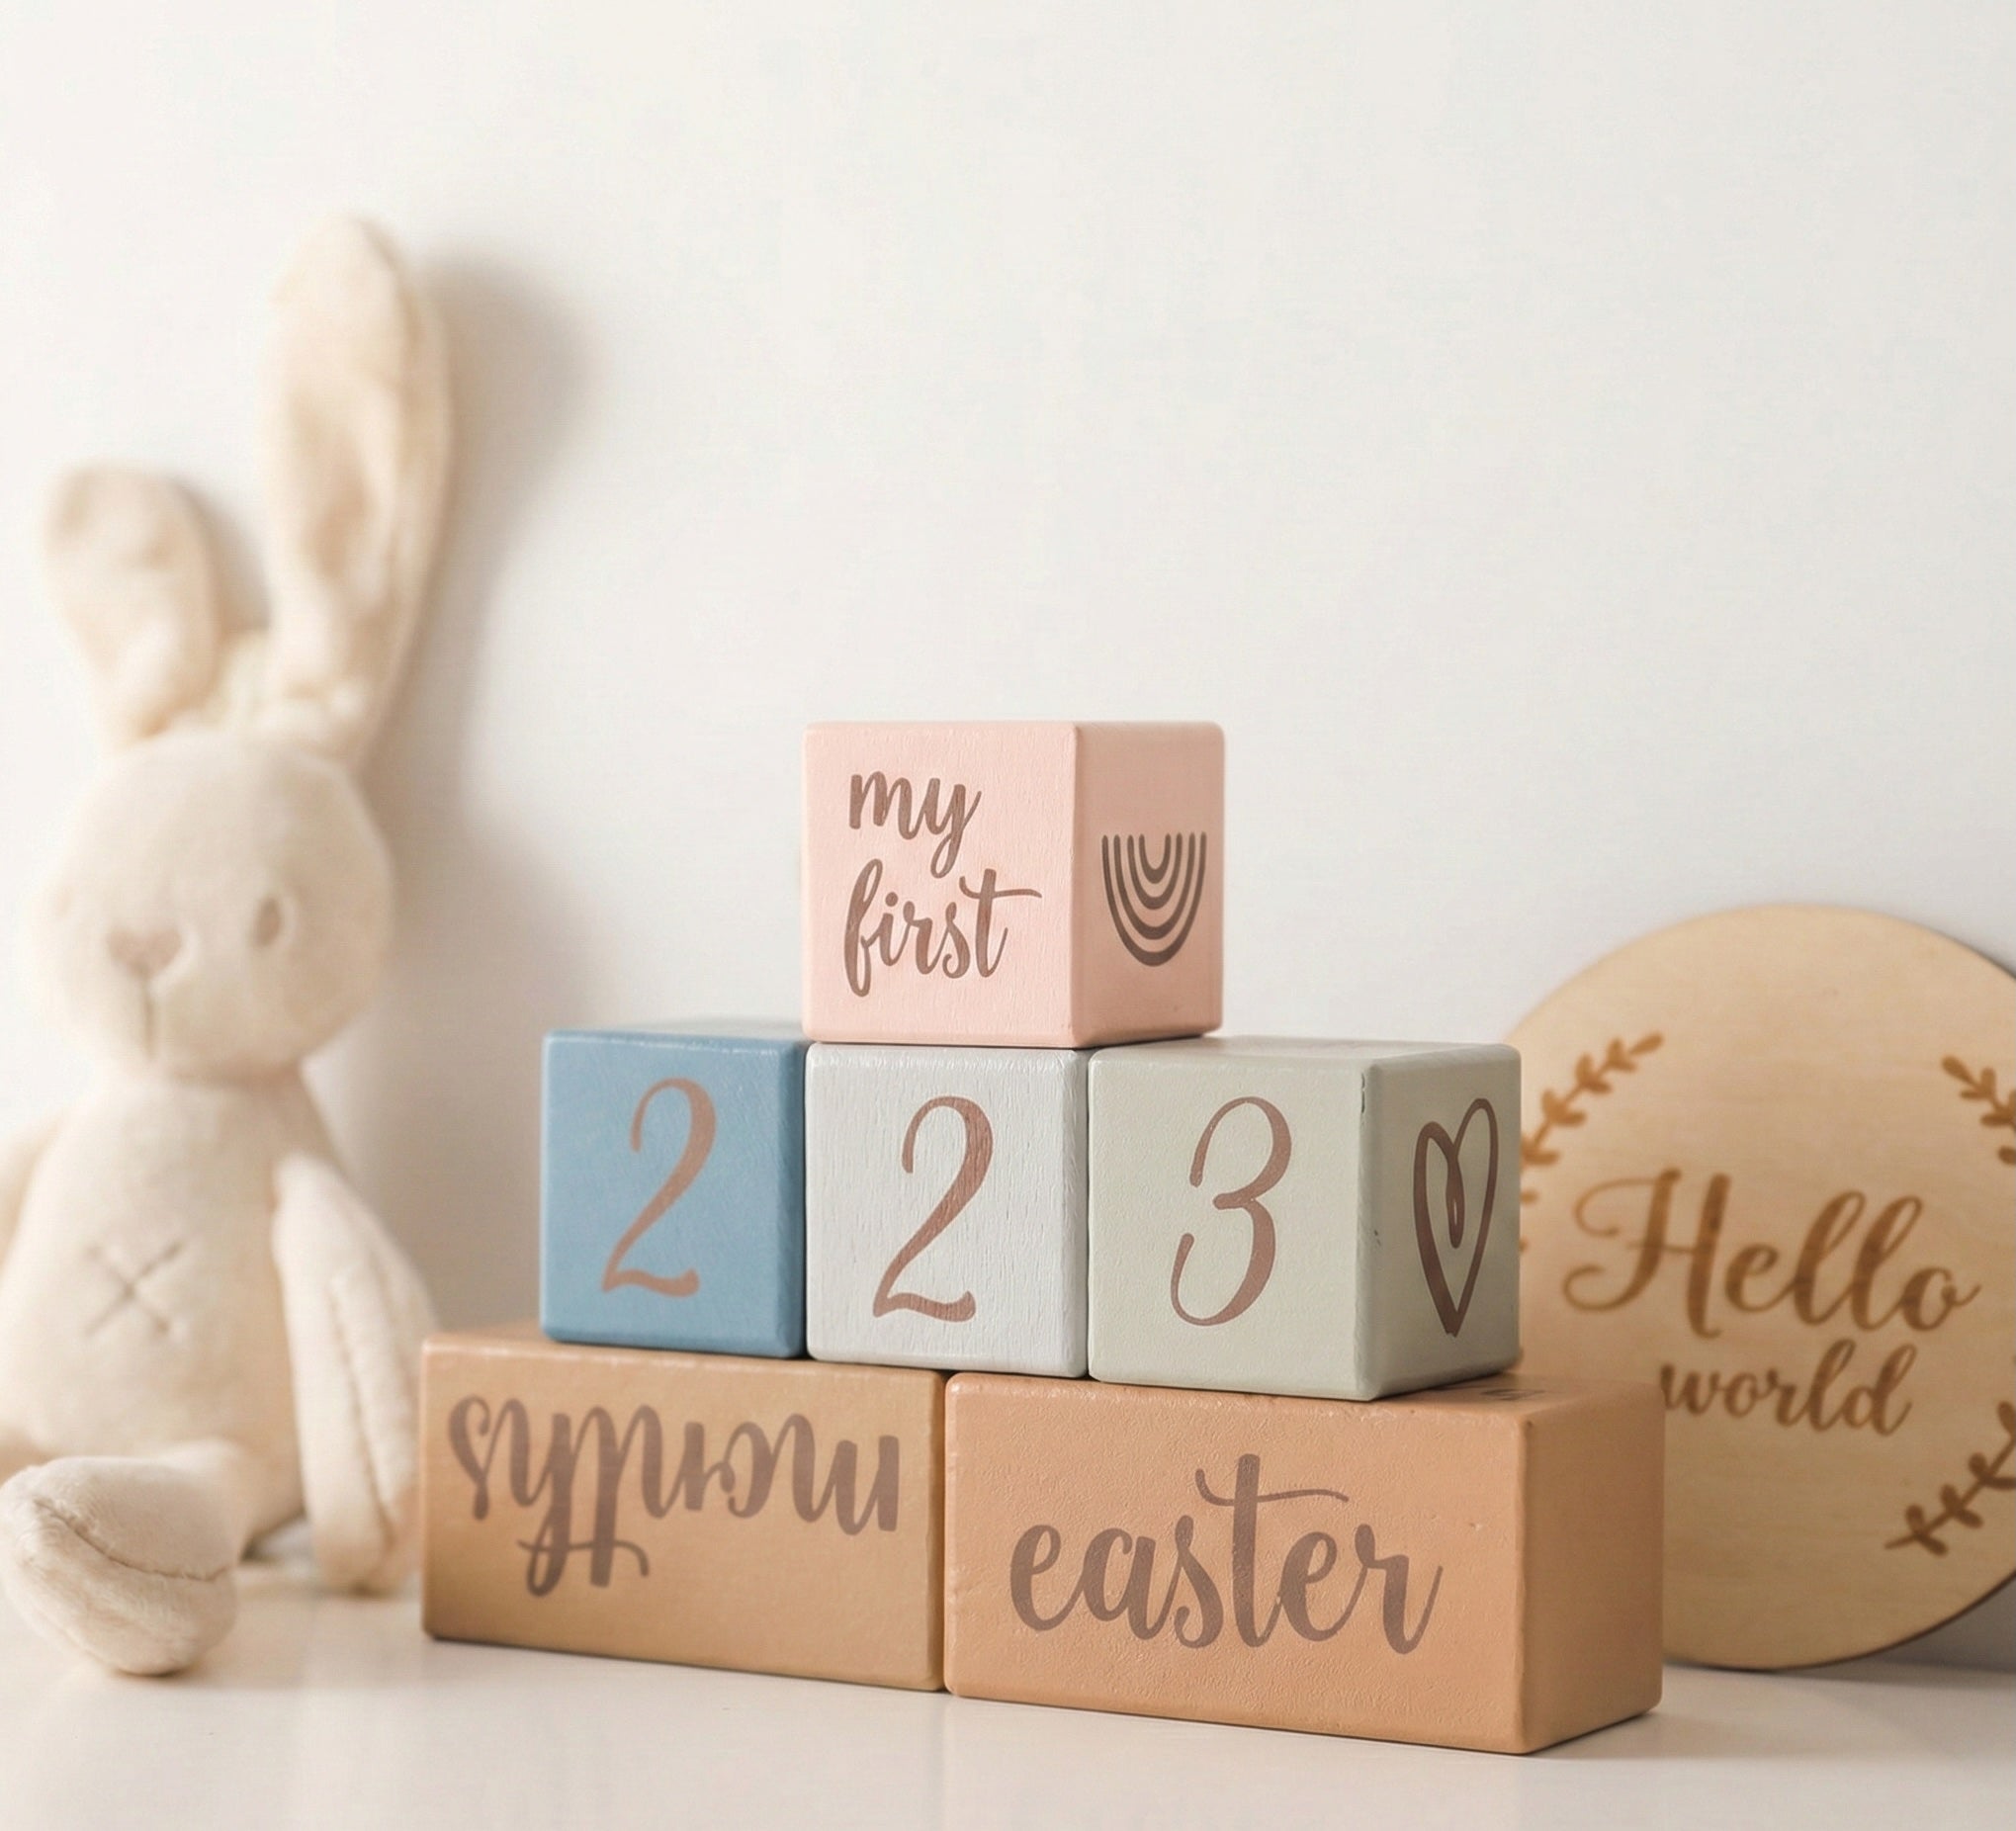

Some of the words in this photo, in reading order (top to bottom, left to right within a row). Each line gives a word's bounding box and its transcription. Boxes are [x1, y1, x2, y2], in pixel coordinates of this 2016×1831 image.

[848, 771, 982, 879] my
[844, 858, 1042, 998] first
[601, 1078, 716, 1297] 2
[872, 1095, 994, 1323] 2
[1170, 1096, 1292, 1327] 3
[1562, 1168, 1982, 1341] Hello
[1660, 1339, 1919, 1437] world
[448, 1394, 901, 1598] months
[1008, 1453, 1444, 1655] easter
